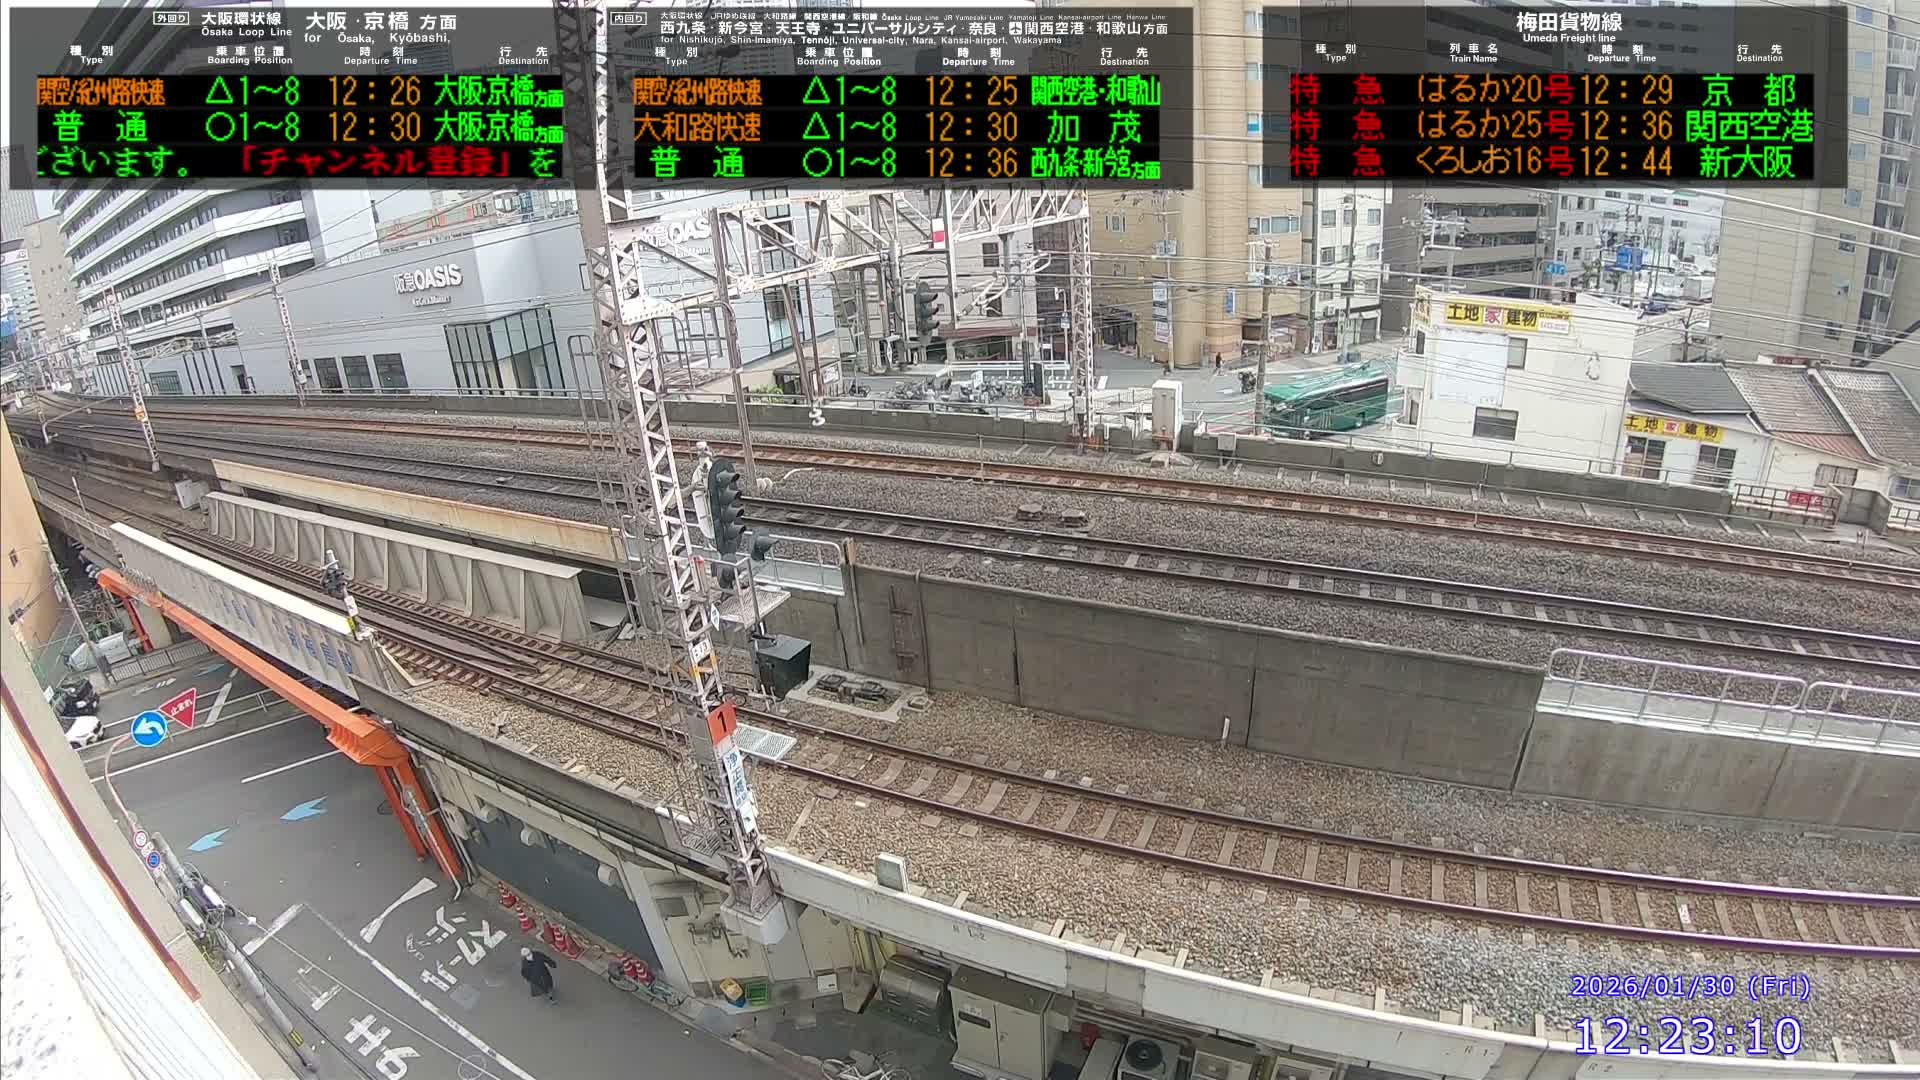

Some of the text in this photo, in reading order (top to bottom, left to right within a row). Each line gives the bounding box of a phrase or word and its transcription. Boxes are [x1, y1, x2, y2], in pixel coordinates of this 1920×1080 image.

[170, 698, 194, 718] 止まれ
[716, 711, 728, 734] 1
